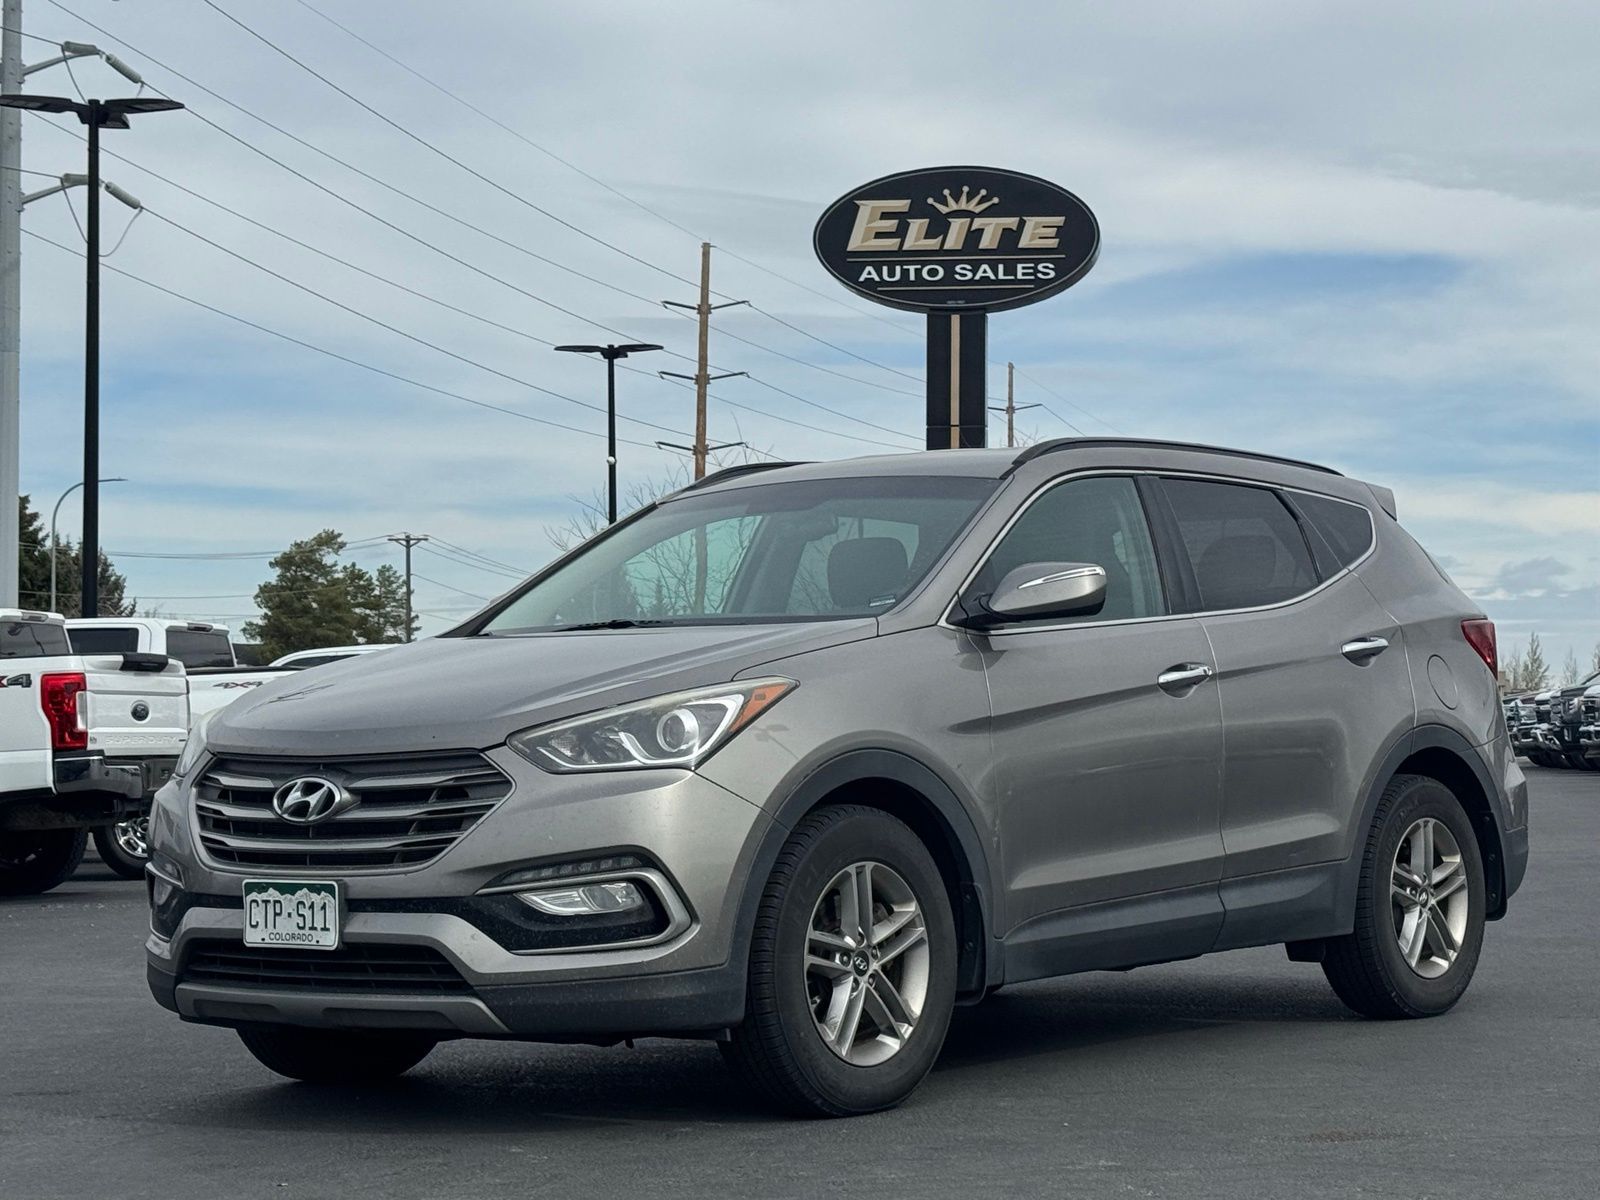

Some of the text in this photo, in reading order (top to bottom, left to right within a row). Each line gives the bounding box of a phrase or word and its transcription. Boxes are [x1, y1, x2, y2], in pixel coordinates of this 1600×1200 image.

[847, 199, 1066, 251] ELITE
[858, 263, 1056, 282] AUTO SALES
[268, 932, 314, 943] COLORADO
